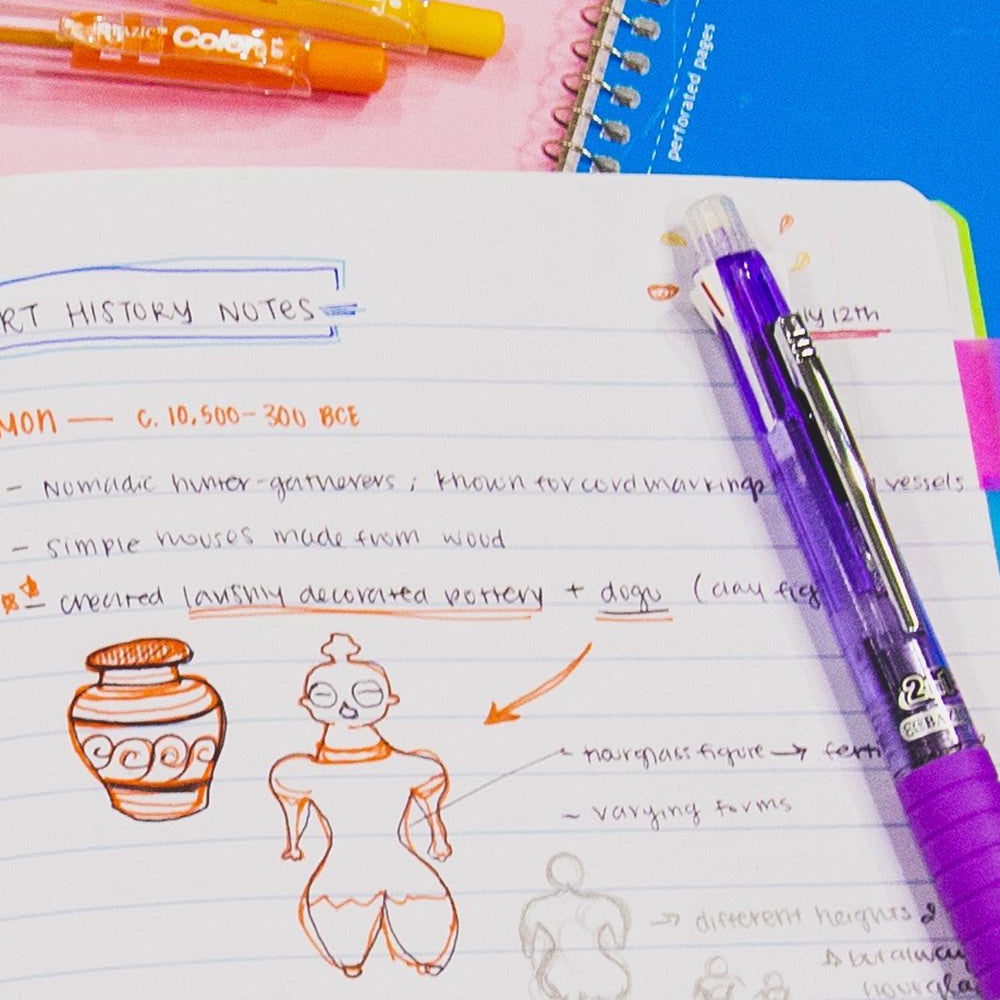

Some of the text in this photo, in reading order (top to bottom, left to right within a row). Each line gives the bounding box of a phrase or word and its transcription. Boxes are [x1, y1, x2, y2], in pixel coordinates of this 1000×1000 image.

[668, 23, 716, 163] perforated pages
[68, 299, 193, 328] HISTORY
[832, 305, 880, 323] 12th
[319, 404, 360, 428] BCE
[436, 470, 525, 492] known
[537, 473, 575, 493] for
[581, 473, 636, 493] cord
[886, 472, 964, 492] vessels
[47, 526, 505, 559] simple houses made from wood
[60, 586, 163, 616] created
[299, 583, 428, 605] decorated
[444, 584, 543, 611] pottery
[592, 796, 793, 831] varying forms
[695, 907, 802, 933] different
[814, 905, 912, 933] heights
